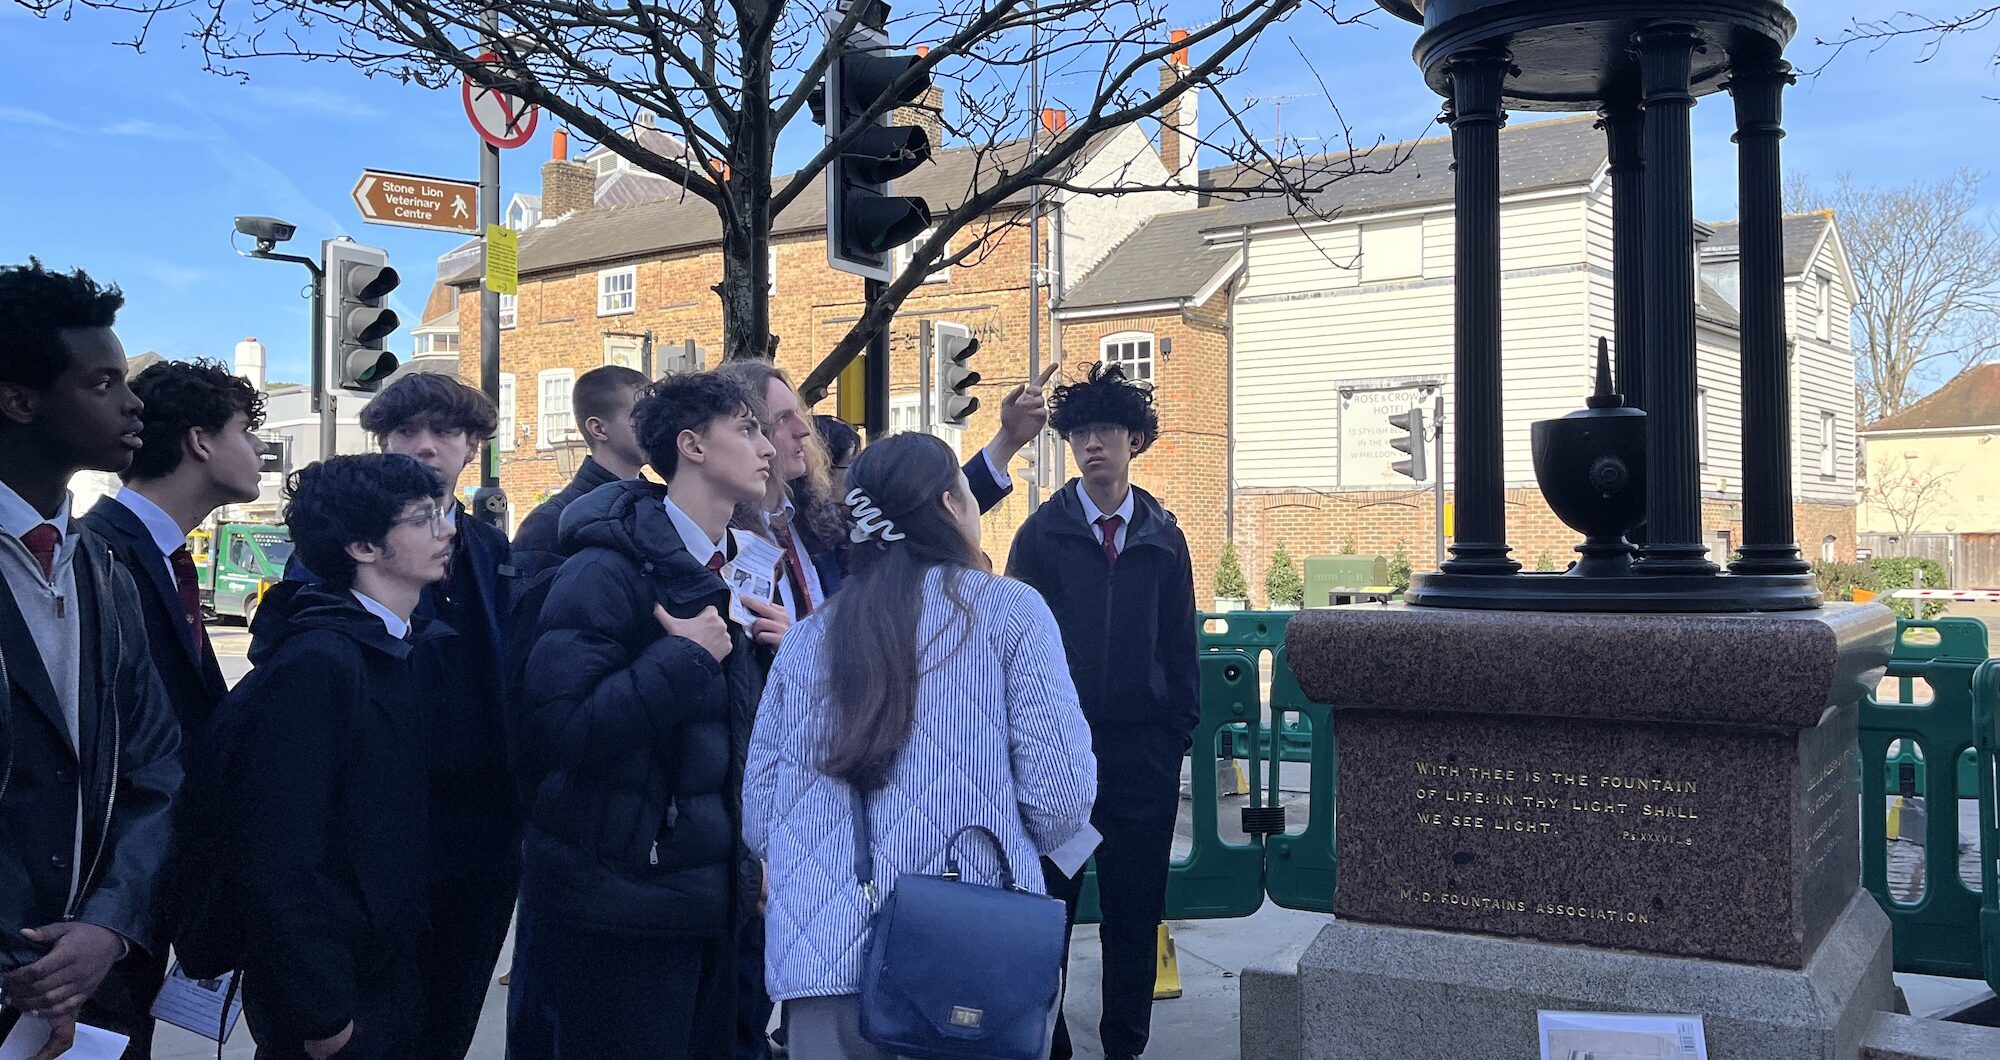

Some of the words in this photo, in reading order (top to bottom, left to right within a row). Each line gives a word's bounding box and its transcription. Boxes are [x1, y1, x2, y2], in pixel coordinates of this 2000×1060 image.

[382, 181, 415, 194] Stone
[421, 185, 444, 198] Lion
[385, 193, 441, 211] Veterinary
[394, 206, 432, 220] Centre
[1354, 394, 1380, 404] ROSE
[1373, 405, 1404, 415] HOTEL
[1358, 427, 1388, 435] STYLISH
[1350, 450, 1397, 459] WIMBLEDON
[1416, 762, 1460, 777] WITH
[1469, 767, 1514, 781] THEE
[1525, 771, 1541, 783] IS
[1552, 772, 1588, 786] THE
[1600, 776, 1697, 793] FOUNTAIN
[1416, 788, 1437, 799] OF
[1496, 794, 1514, 806] IN
[1523, 795, 1558, 809] THY
[1573, 799, 1628, 814] LIGHT
[1642, 803, 1698, 819] SHALL
[1417, 812, 1442, 825] WE
[1452, 816, 1484, 828] SEE
